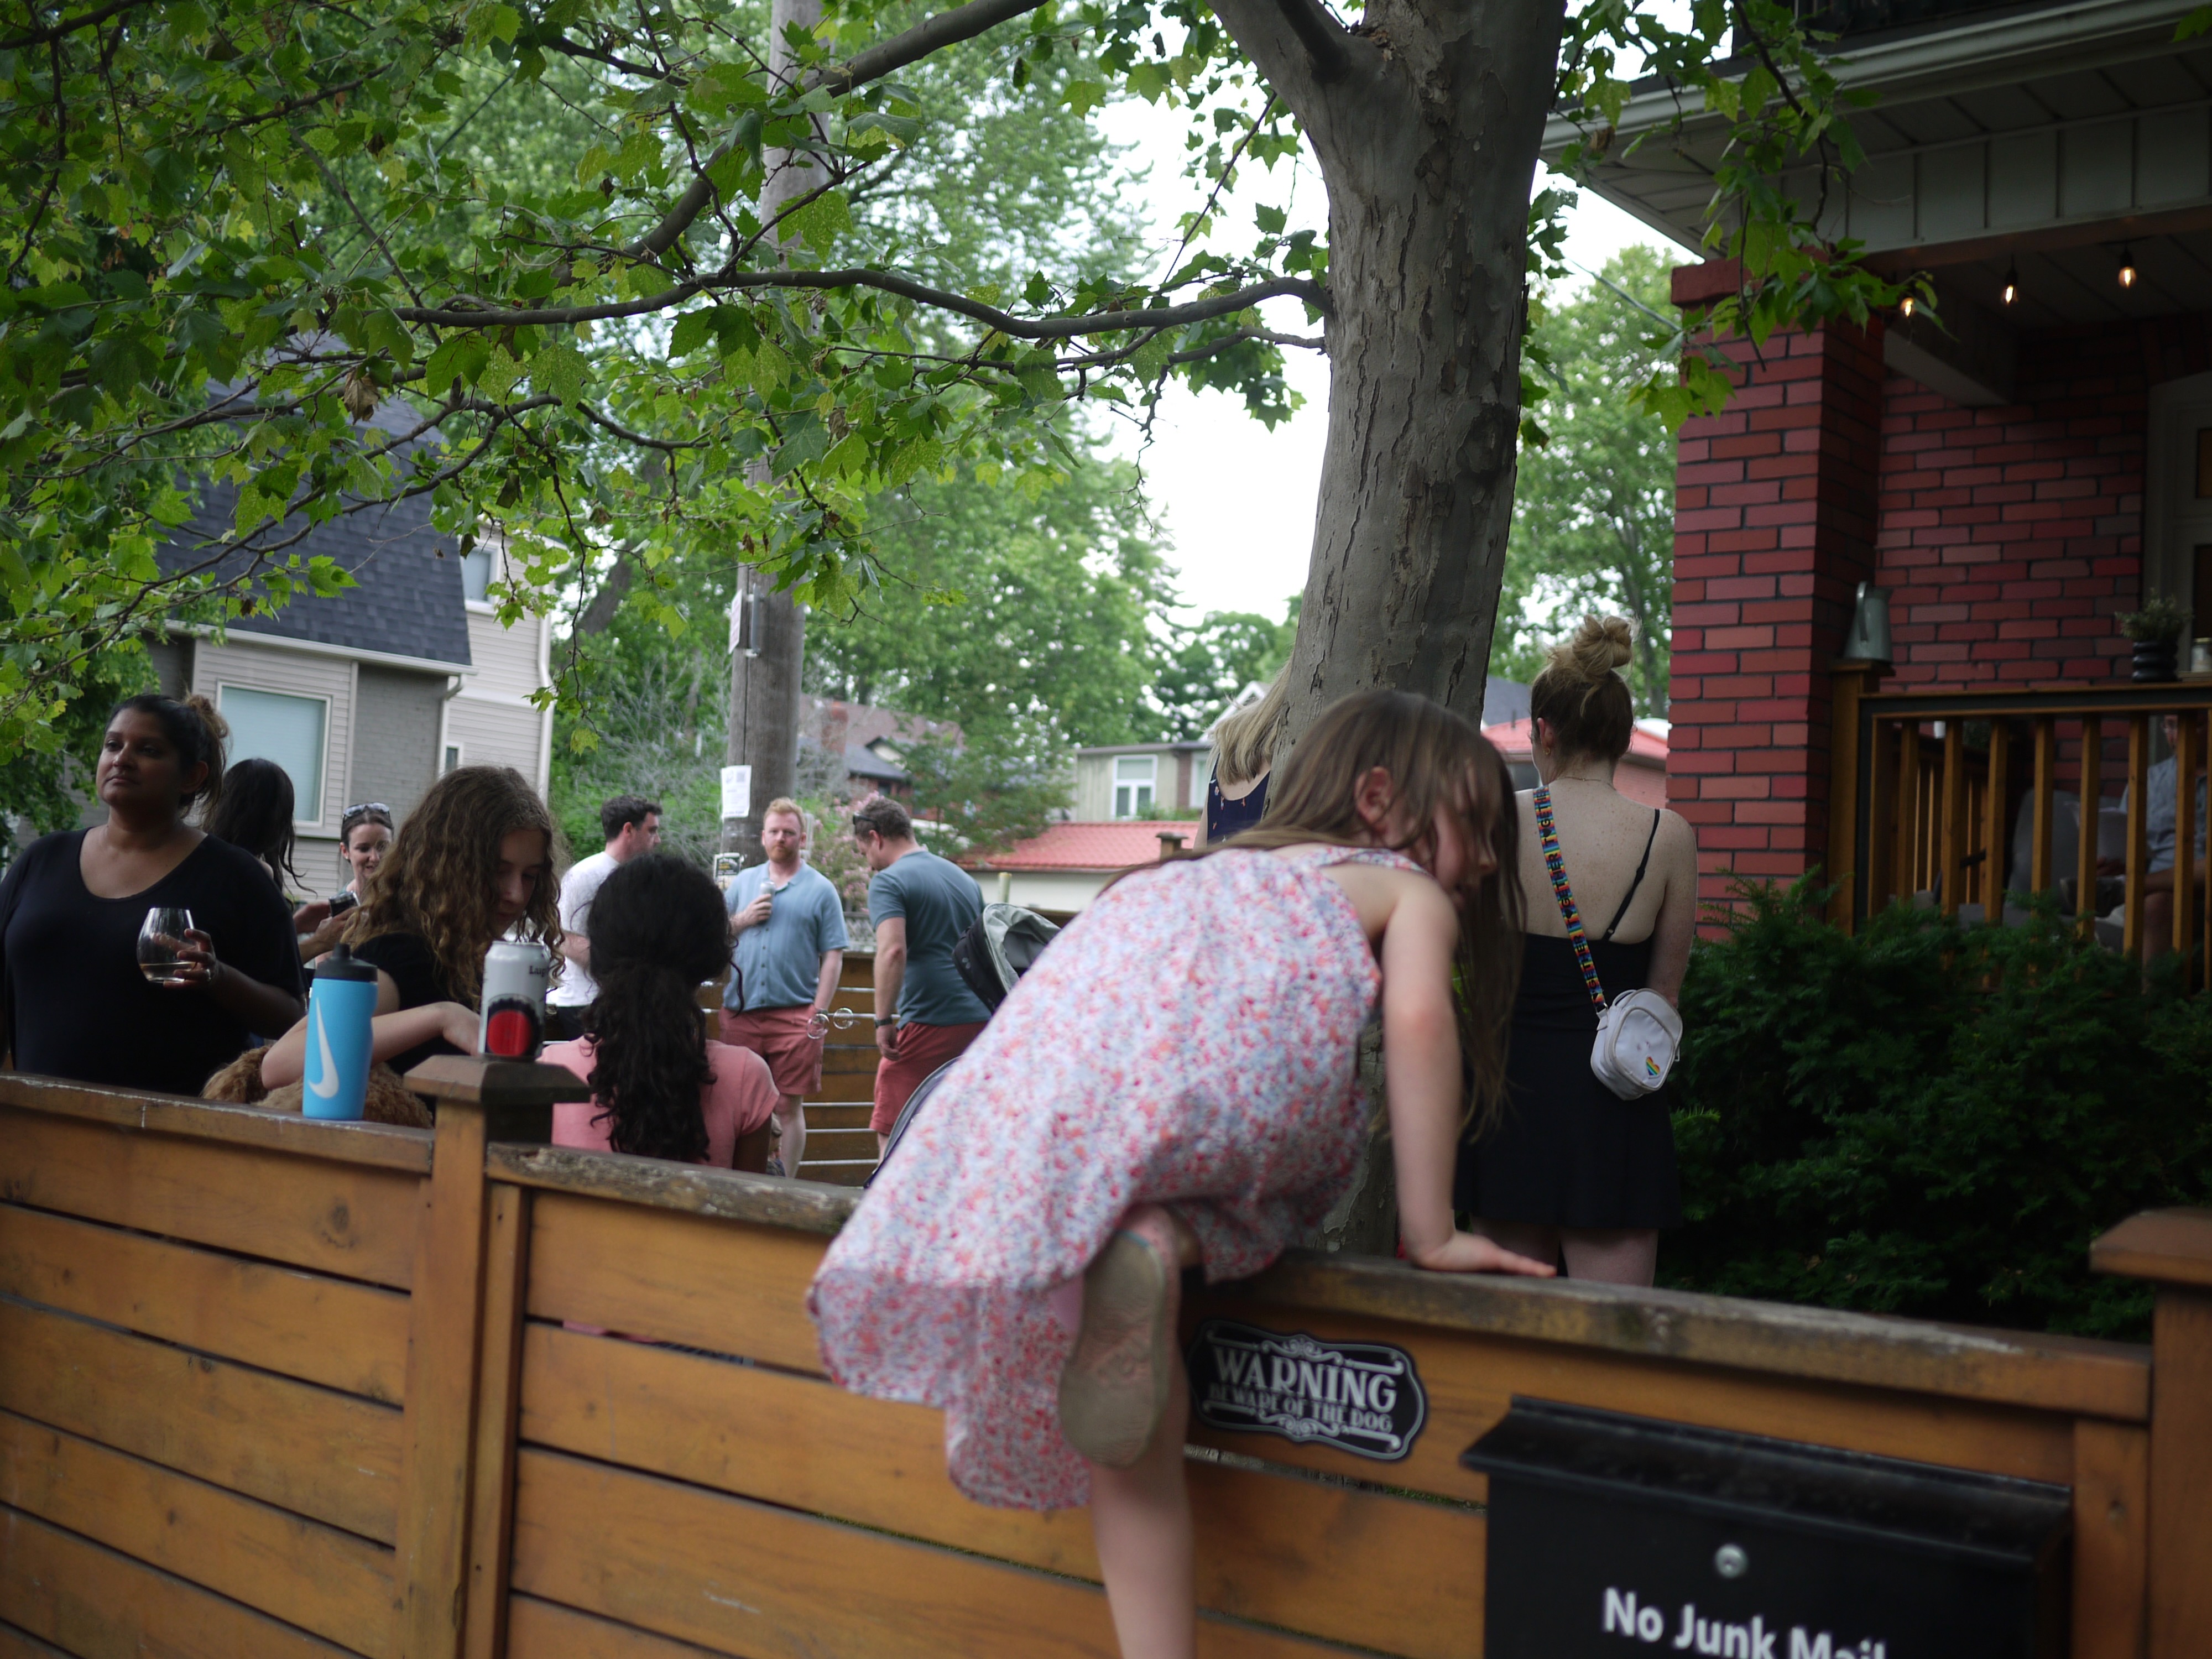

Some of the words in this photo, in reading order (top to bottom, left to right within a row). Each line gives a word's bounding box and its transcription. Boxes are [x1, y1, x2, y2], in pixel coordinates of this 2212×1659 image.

[1209, 1383, 1281, 1412] BEWARE
[1282, 1396, 1308, 1417] OF
[1311, 1400, 1348, 1423] THE
[1350, 1408, 1393, 1432] DOG
[1214, 1347, 1397, 1413] WARNING
[1604, 1587, 1664, 1642] No
[1673, 1603, 1777, 1659] Junk
